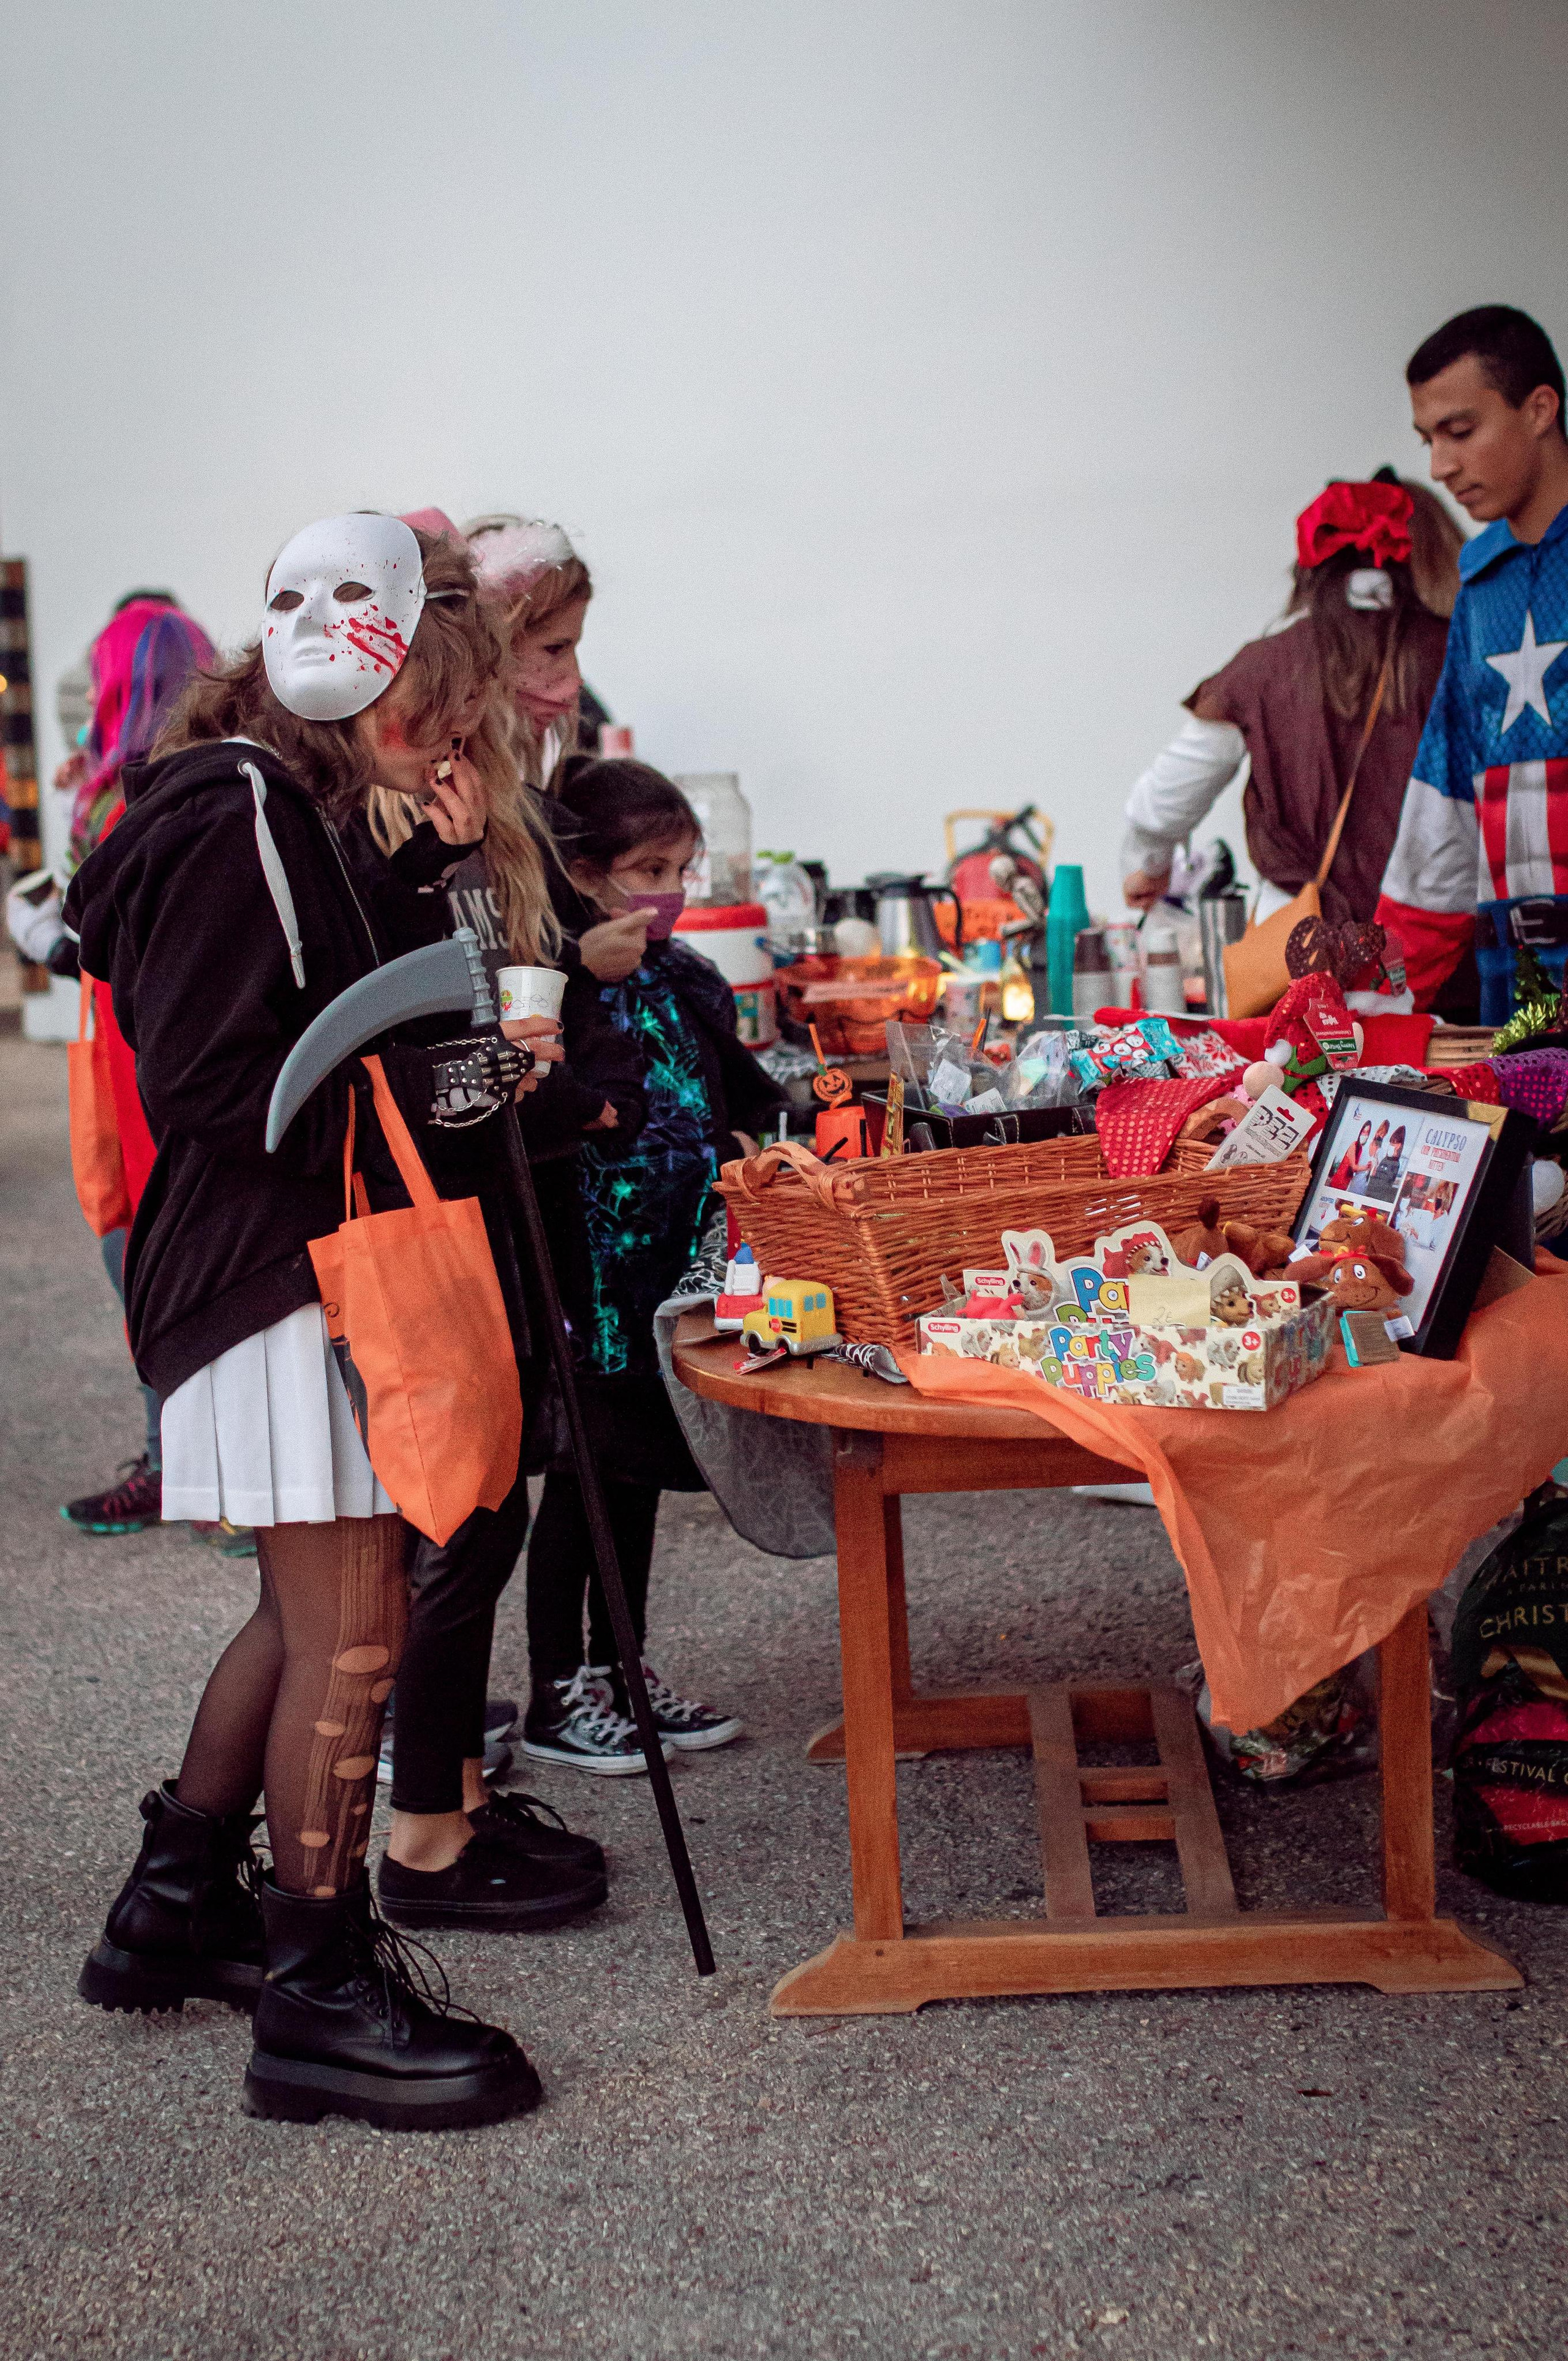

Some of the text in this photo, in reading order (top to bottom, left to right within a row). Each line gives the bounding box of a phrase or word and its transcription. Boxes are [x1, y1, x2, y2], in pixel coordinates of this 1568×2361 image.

[1425, 1128, 1467, 1151] CALYPSO
[1071, 1267, 1129, 1314] Pa
[930, 1324, 959, 1332] Schylling
[1244, 1335, 1259, 1346] 3+
[1050, 1327, 1133, 1362] Party
[1041, 1354, 1156, 1397] Puppies
